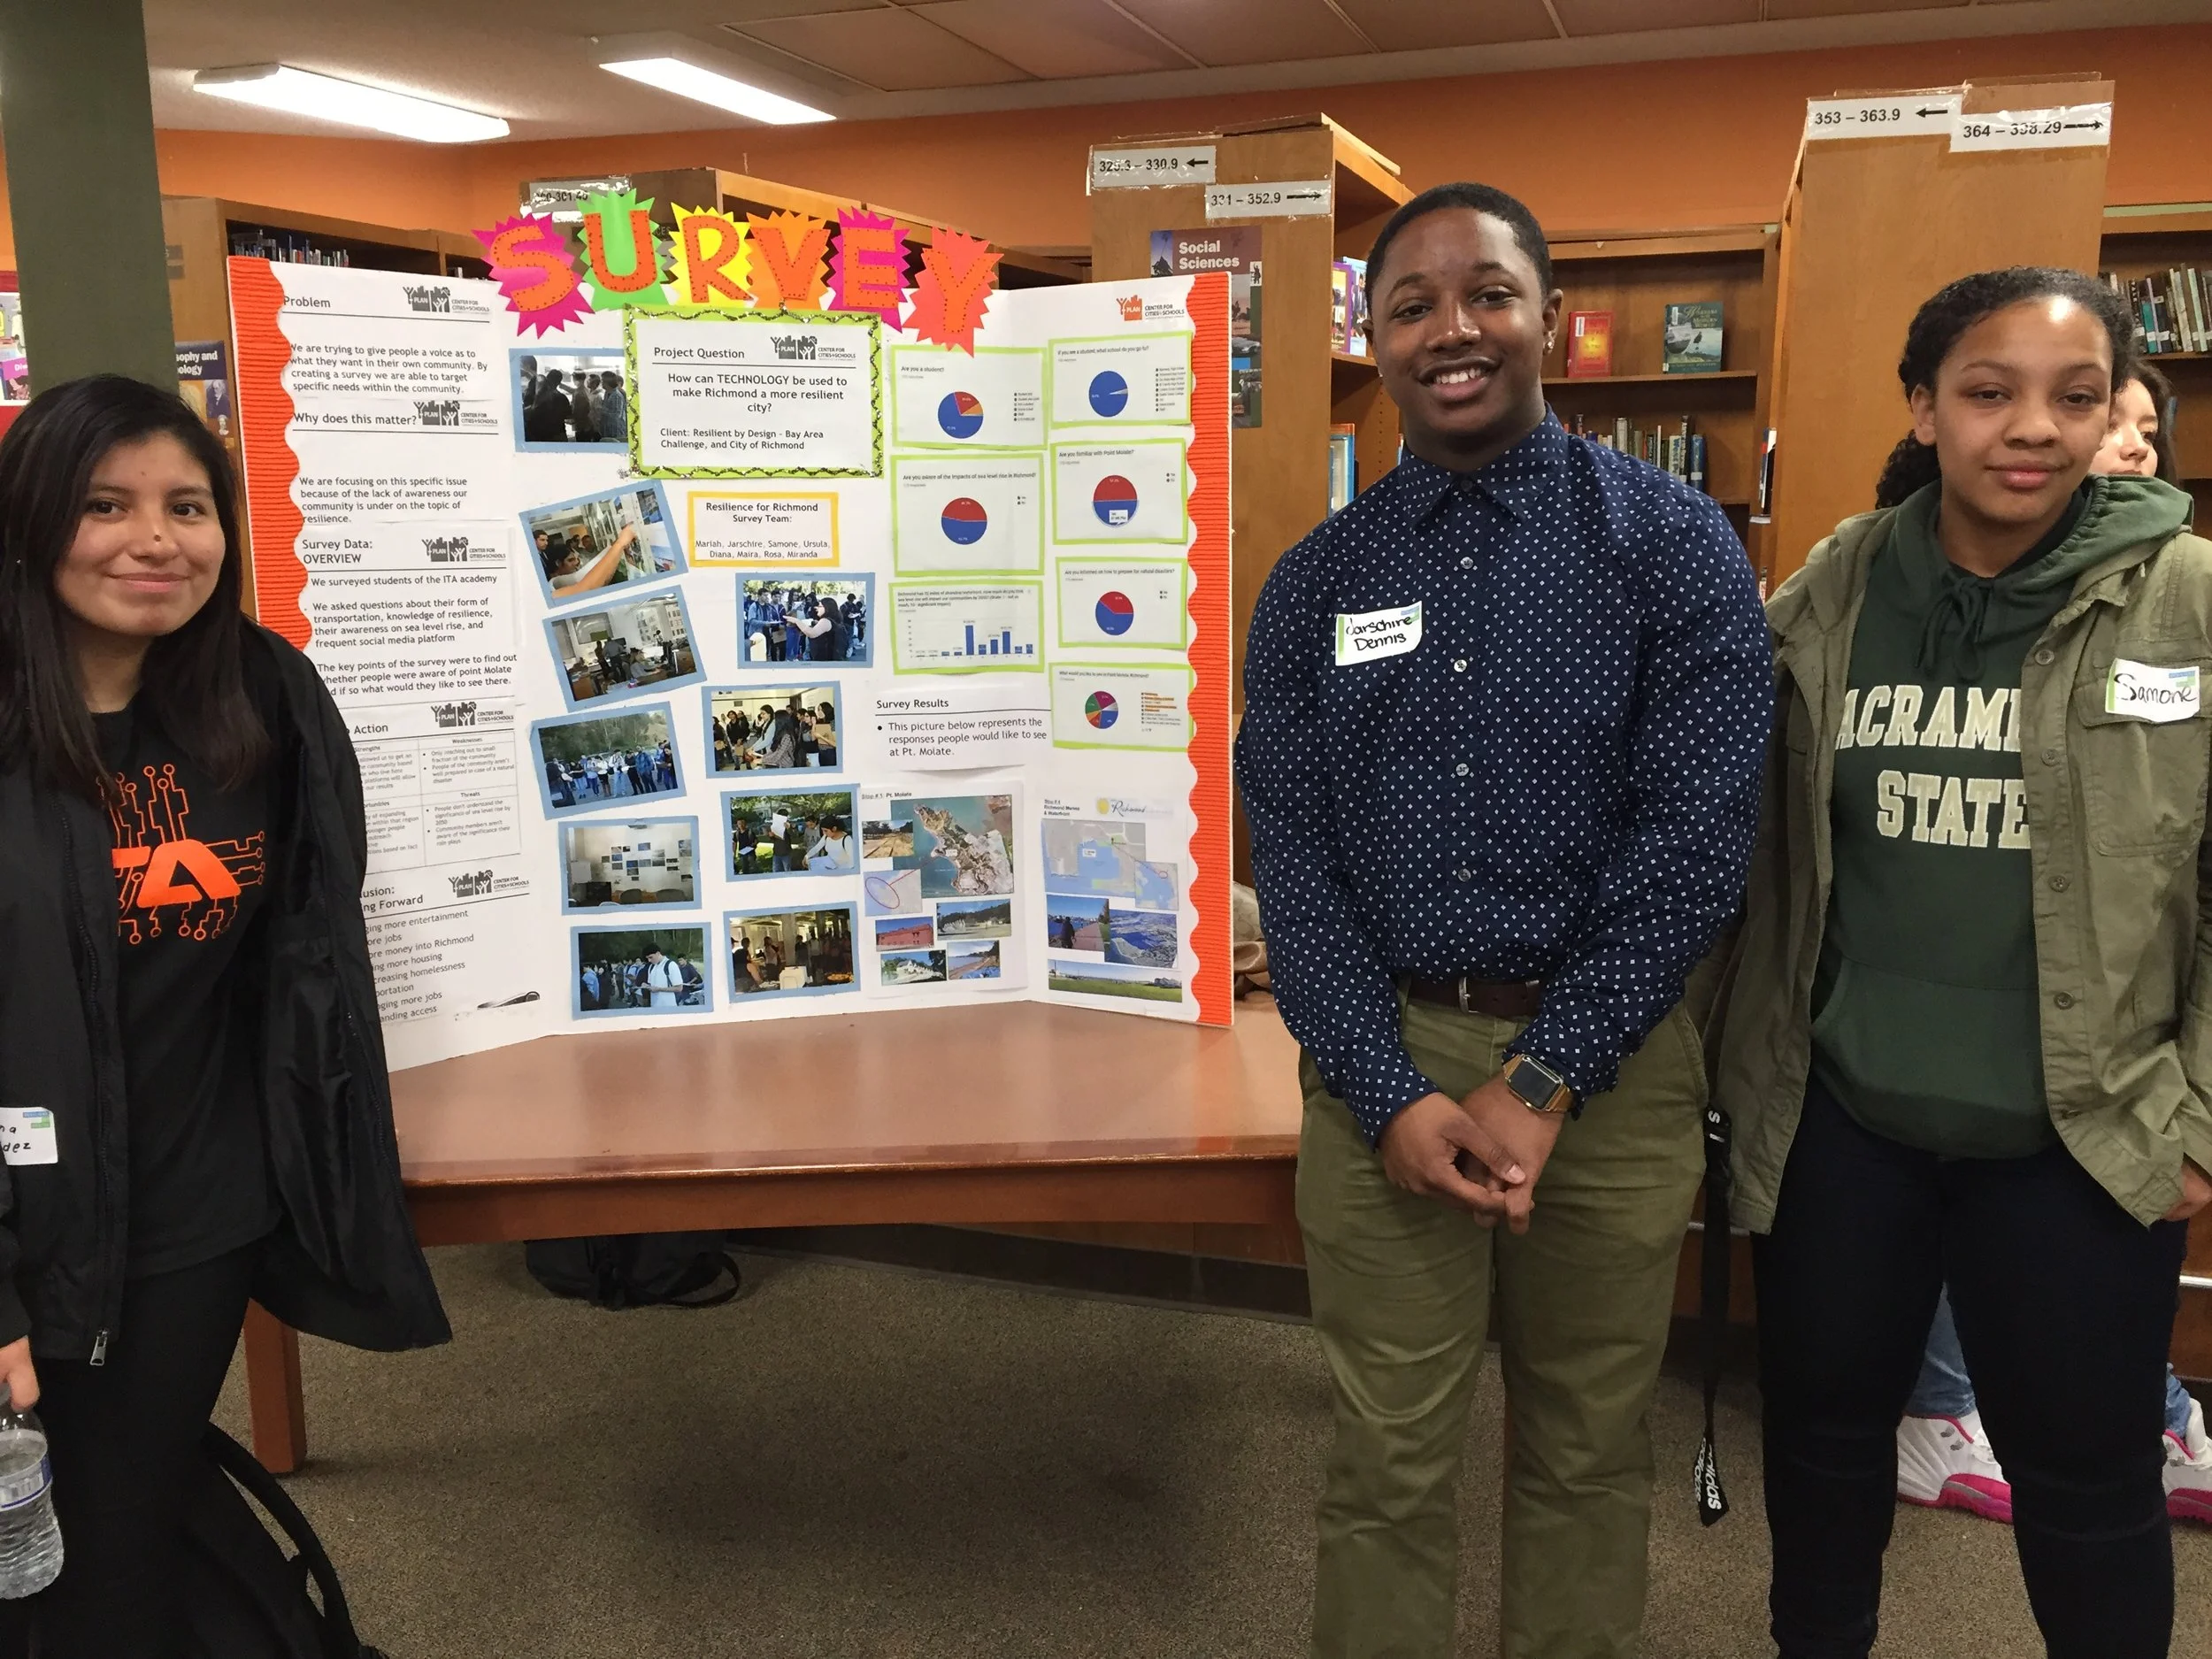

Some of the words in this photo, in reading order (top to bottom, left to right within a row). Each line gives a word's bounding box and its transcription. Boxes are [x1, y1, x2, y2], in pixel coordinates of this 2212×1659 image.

[1815, 111, 1841, 125] 353
[1860, 108, 1901, 123] 363.9
[1962, 125, 1991, 138] 364
[1146, 157, 1179, 171] 330.9
[1248, 191, 1281, 204] 352.9
[1179, 240, 1221, 255] Social
[1179, 256, 1240, 270] Sciences
[490, 209, 995, 334] SURVEY
[284, 296, 331, 308] Problem
[201, 350, 219, 361] and
[324, 345, 352, 356] trying
[366, 346, 386, 356] give
[388, 347, 419, 357] people
[654, 347, 694, 358] Project
[697, 348, 744, 358] Question
[288, 355, 313, 365] what
[316, 357, 337, 367] they
[377, 358, 399, 367] their
[423, 362, 474, 371] community.
[477, 361, 488, 372] By
[291, 369, 331, 380] creating
[341, 372, 372, 380] survey
[408, 372, 427, 380] able
[441, 373, 467, 382] target
[668, 373, 691, 382] How
[717, 373, 789, 385] TECHNOLOGY
[793, 375, 805, 385] be
[809, 376, 833, 385] used
[836, 377, 847, 386] to
[293, 381, 329, 392] specific
[333, 382, 359, 391] needs
[394, 383, 409, 392] the
[411, 385, 464, 395] community.
[672, 388, 702, 396] make
[705, 388, 757, 397] Richmond
[801, 390, 843, 399] resilient
[747, 403, 772, 414] city?
[294, 412, 319, 425] Why
[322, 413, 348, 423] does
[351, 413, 372, 424] this
[375, 415, 417, 425] matter?
[693, 428, 732, 437] Resilient
[734, 429, 745, 439] by
[748, 429, 776, 439] Design
[785, 430, 801, 439] Bay
[661, 440, 707, 449] Challenge,
[729, 440, 747, 450] City
[757, 503, 770, 511] for
[772, 503, 818, 511] Richmond
[733, 514, 763, 524] Survey
[302, 539, 340, 550] Survey
[344, 539, 372, 549] Data:
[303, 553, 361, 565] OVERVIEW
[1354, 633, 1407, 651] Dennis
[2114, 673, 2197, 704] Samone
[876, 700, 910, 710] Survey
[914, 699, 949, 708] Results
[354, 724, 388, 734] Action
[887, 722, 908, 731] This
[910, 722, 945, 733] picture
[948, 720, 975, 729] below
[978, 718, 1026, 729] represents
[1028, 717, 1042, 726] the
[888, 736, 934, 745] responses
[937, 733, 970, 745] people
[972, 731, 999, 741] would
[1002, 730, 1018, 739] like
[902, 747, 915, 756] Pt.
[919, 747, 954, 756] Molate.
[1877, 769, 2032, 849] STATE
[379, 894, 423, 909] Forward
[384, 920, 406, 929] more
[409, 910, 468, 926] entertainment
[384, 933, 402, 945] jobs
[385, 946, 412, 956] money
[434, 933, 473, 948] Richmond
[387, 959, 408, 968] more
[411, 953, 442, 964] housing
[410, 962, 465, 977] homelessness
[401, 995, 422, 1005] more
[425, 991, 442, 1002] jobs
[410, 1006, 437, 1017] access
